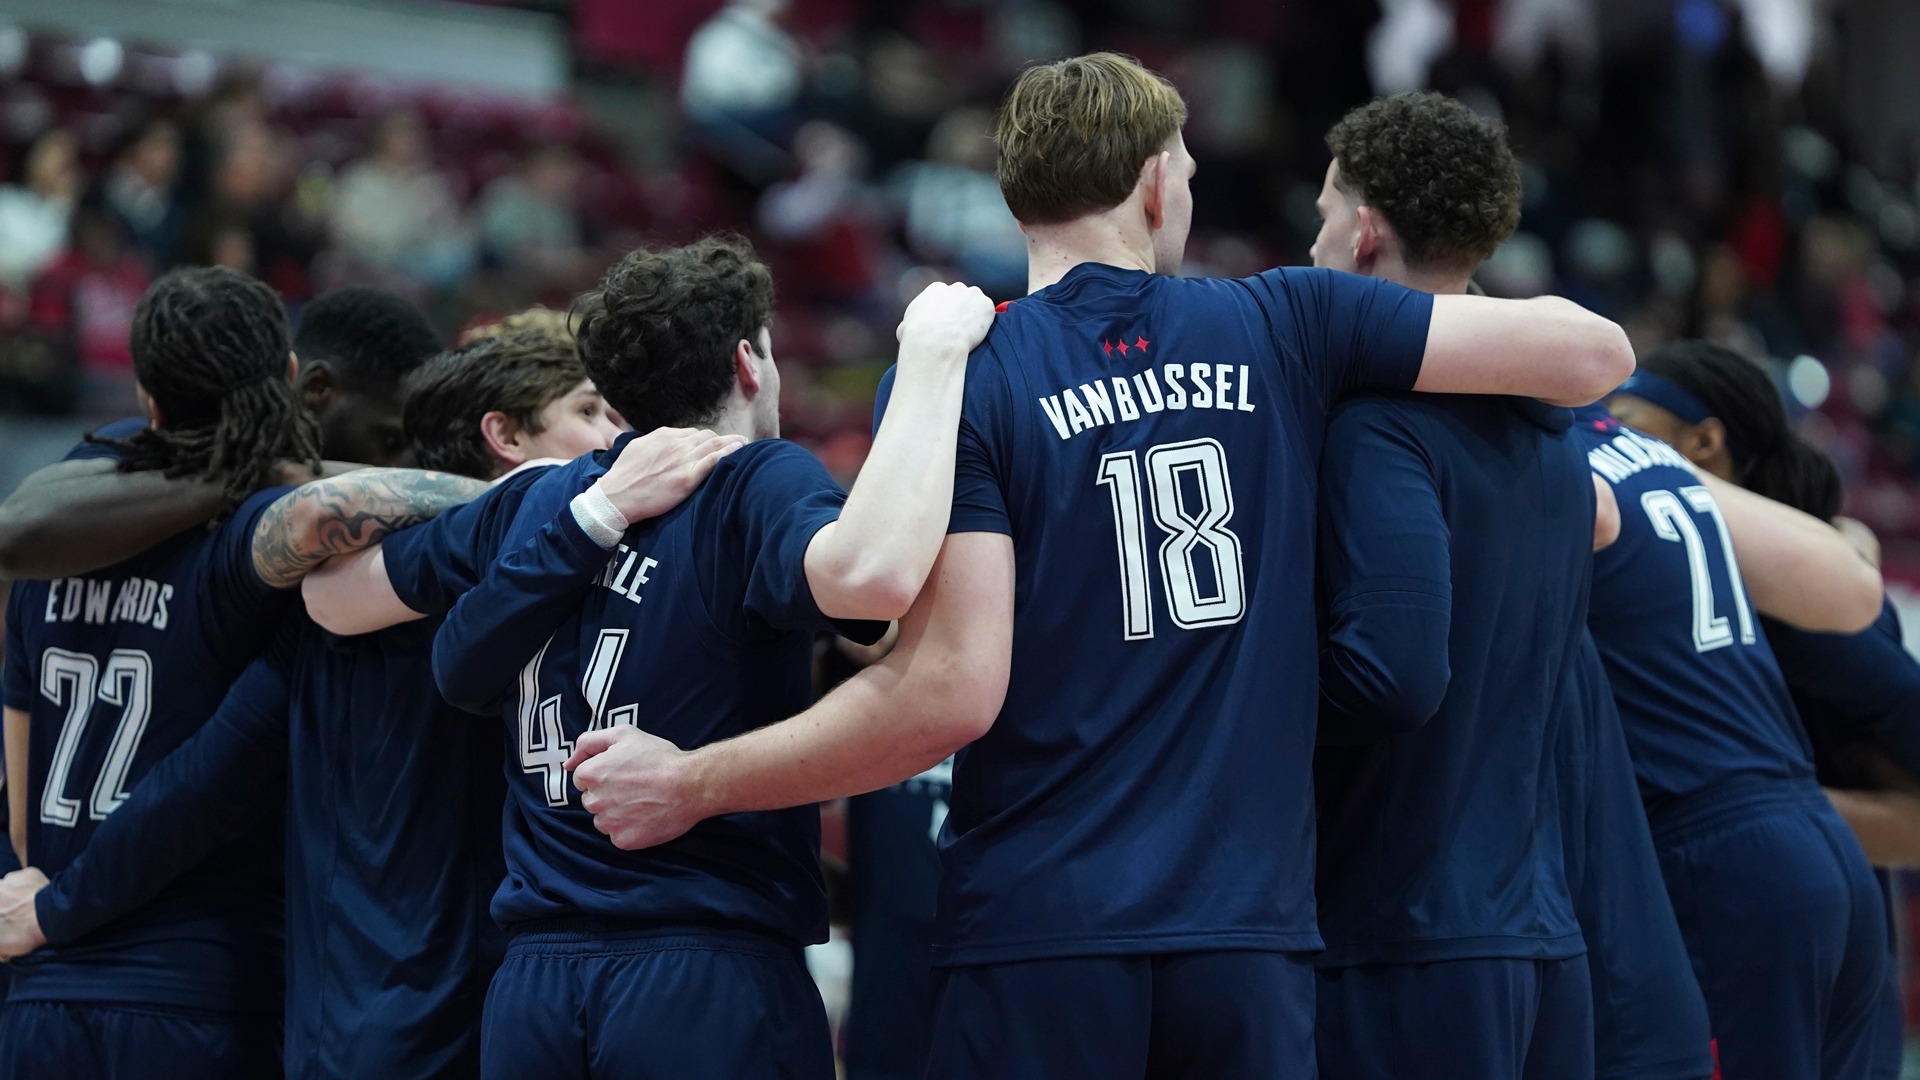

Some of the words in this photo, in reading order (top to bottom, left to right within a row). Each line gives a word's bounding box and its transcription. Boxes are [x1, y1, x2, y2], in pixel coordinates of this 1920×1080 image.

[1039, 362, 1255, 440] VANBUSSEL
[1096, 437, 1246, 641] 18
[40, 647, 152, 827] 22
